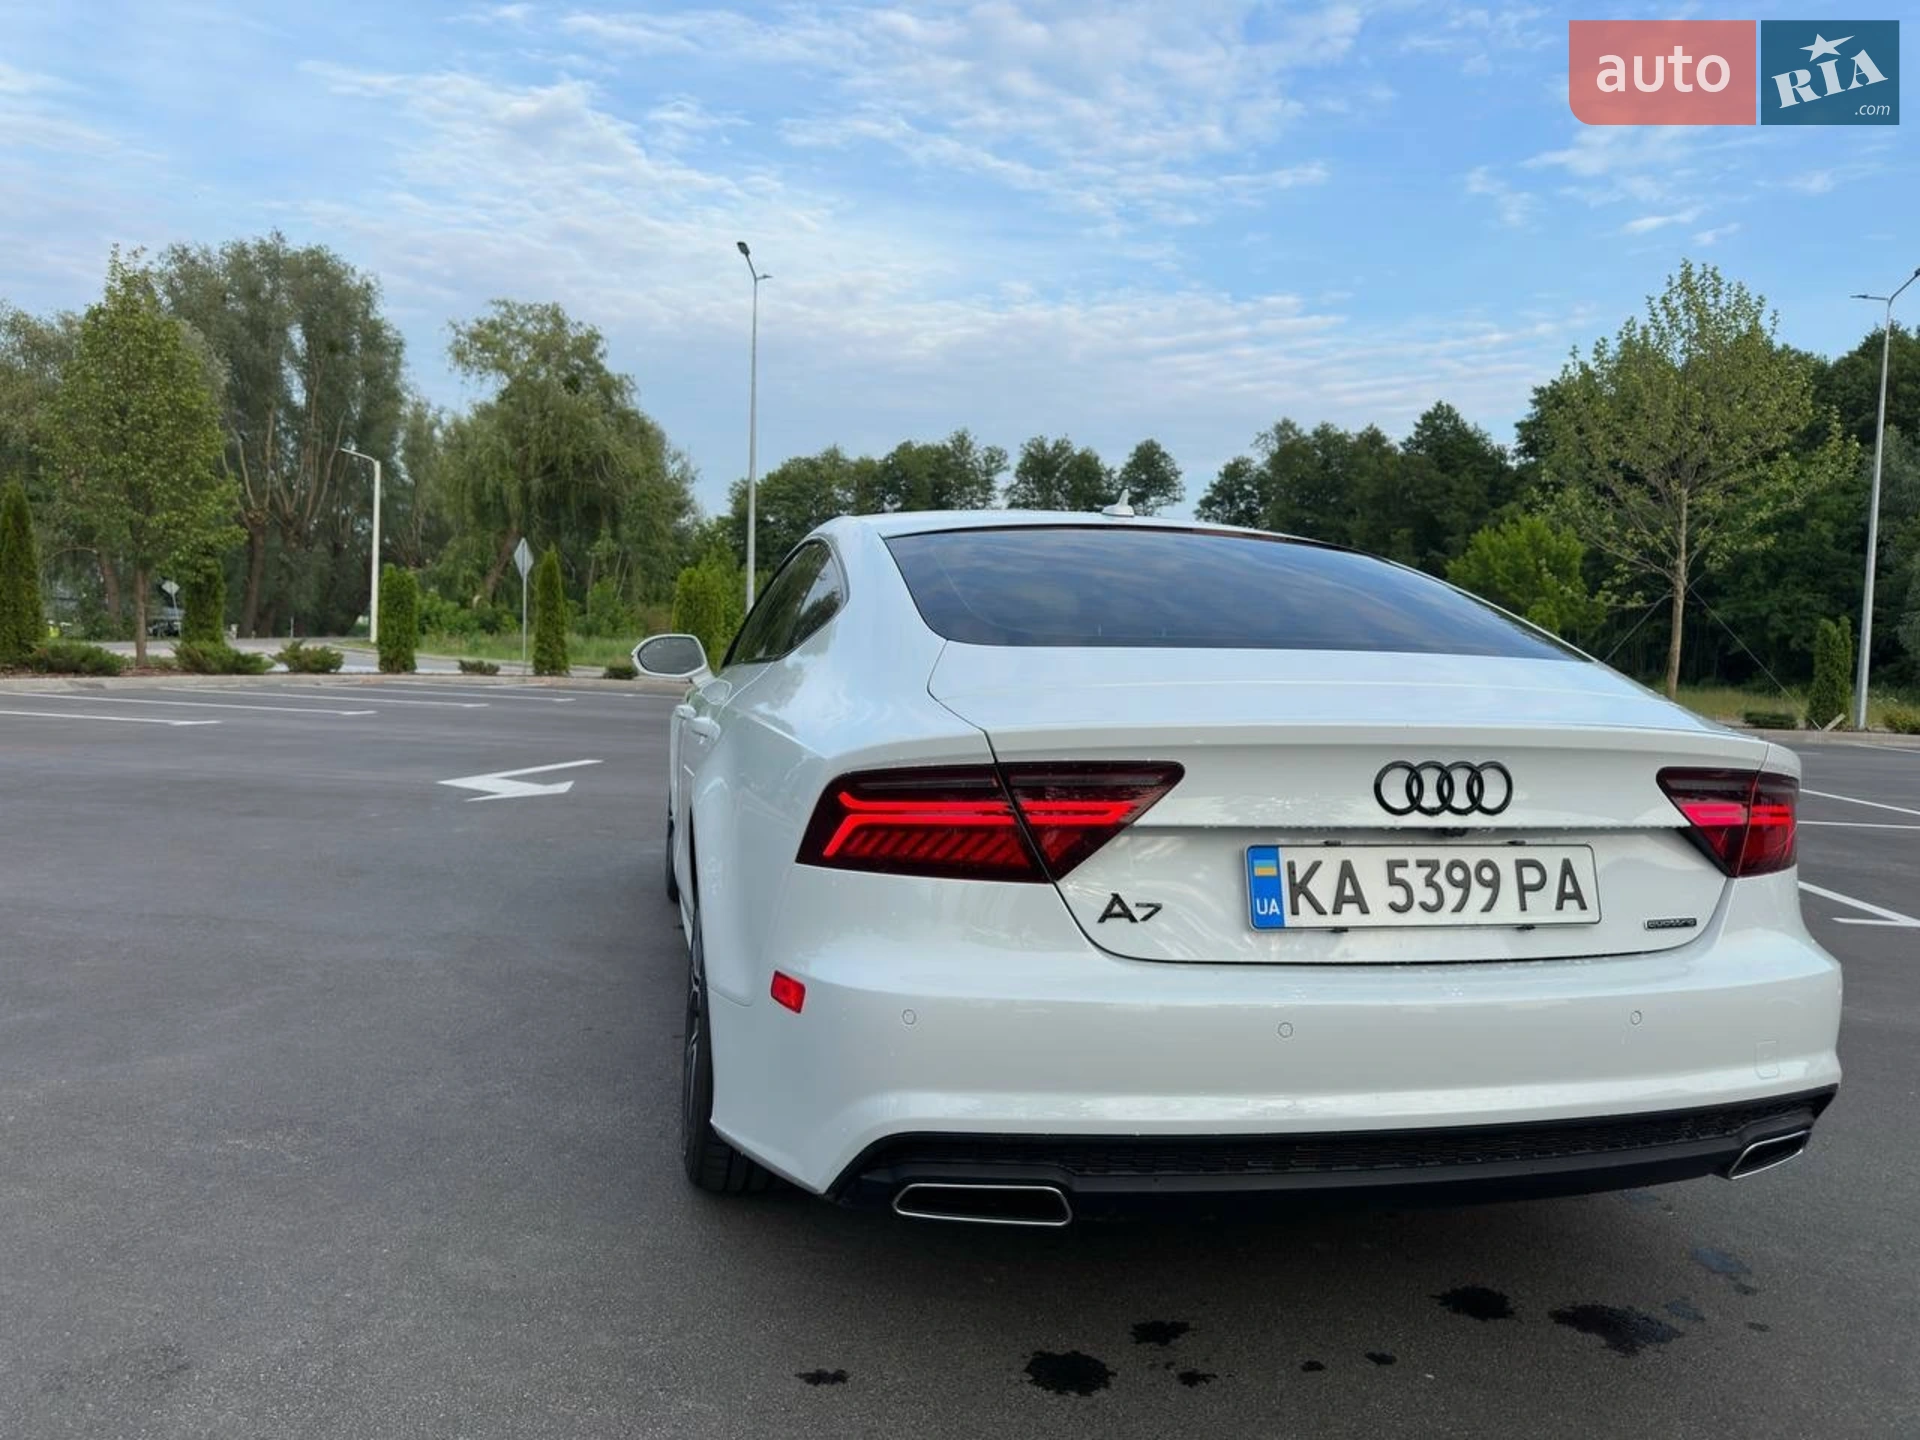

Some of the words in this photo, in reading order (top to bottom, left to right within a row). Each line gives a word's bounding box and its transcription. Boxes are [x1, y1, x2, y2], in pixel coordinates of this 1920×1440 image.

[1286, 859, 1371, 916] KA
[1386, 858, 1501, 914] 5399
[1514, 858, 1588, 912] PA
[1097, 892, 1163, 924] A7
[1256, 897, 1281, 916] UA
